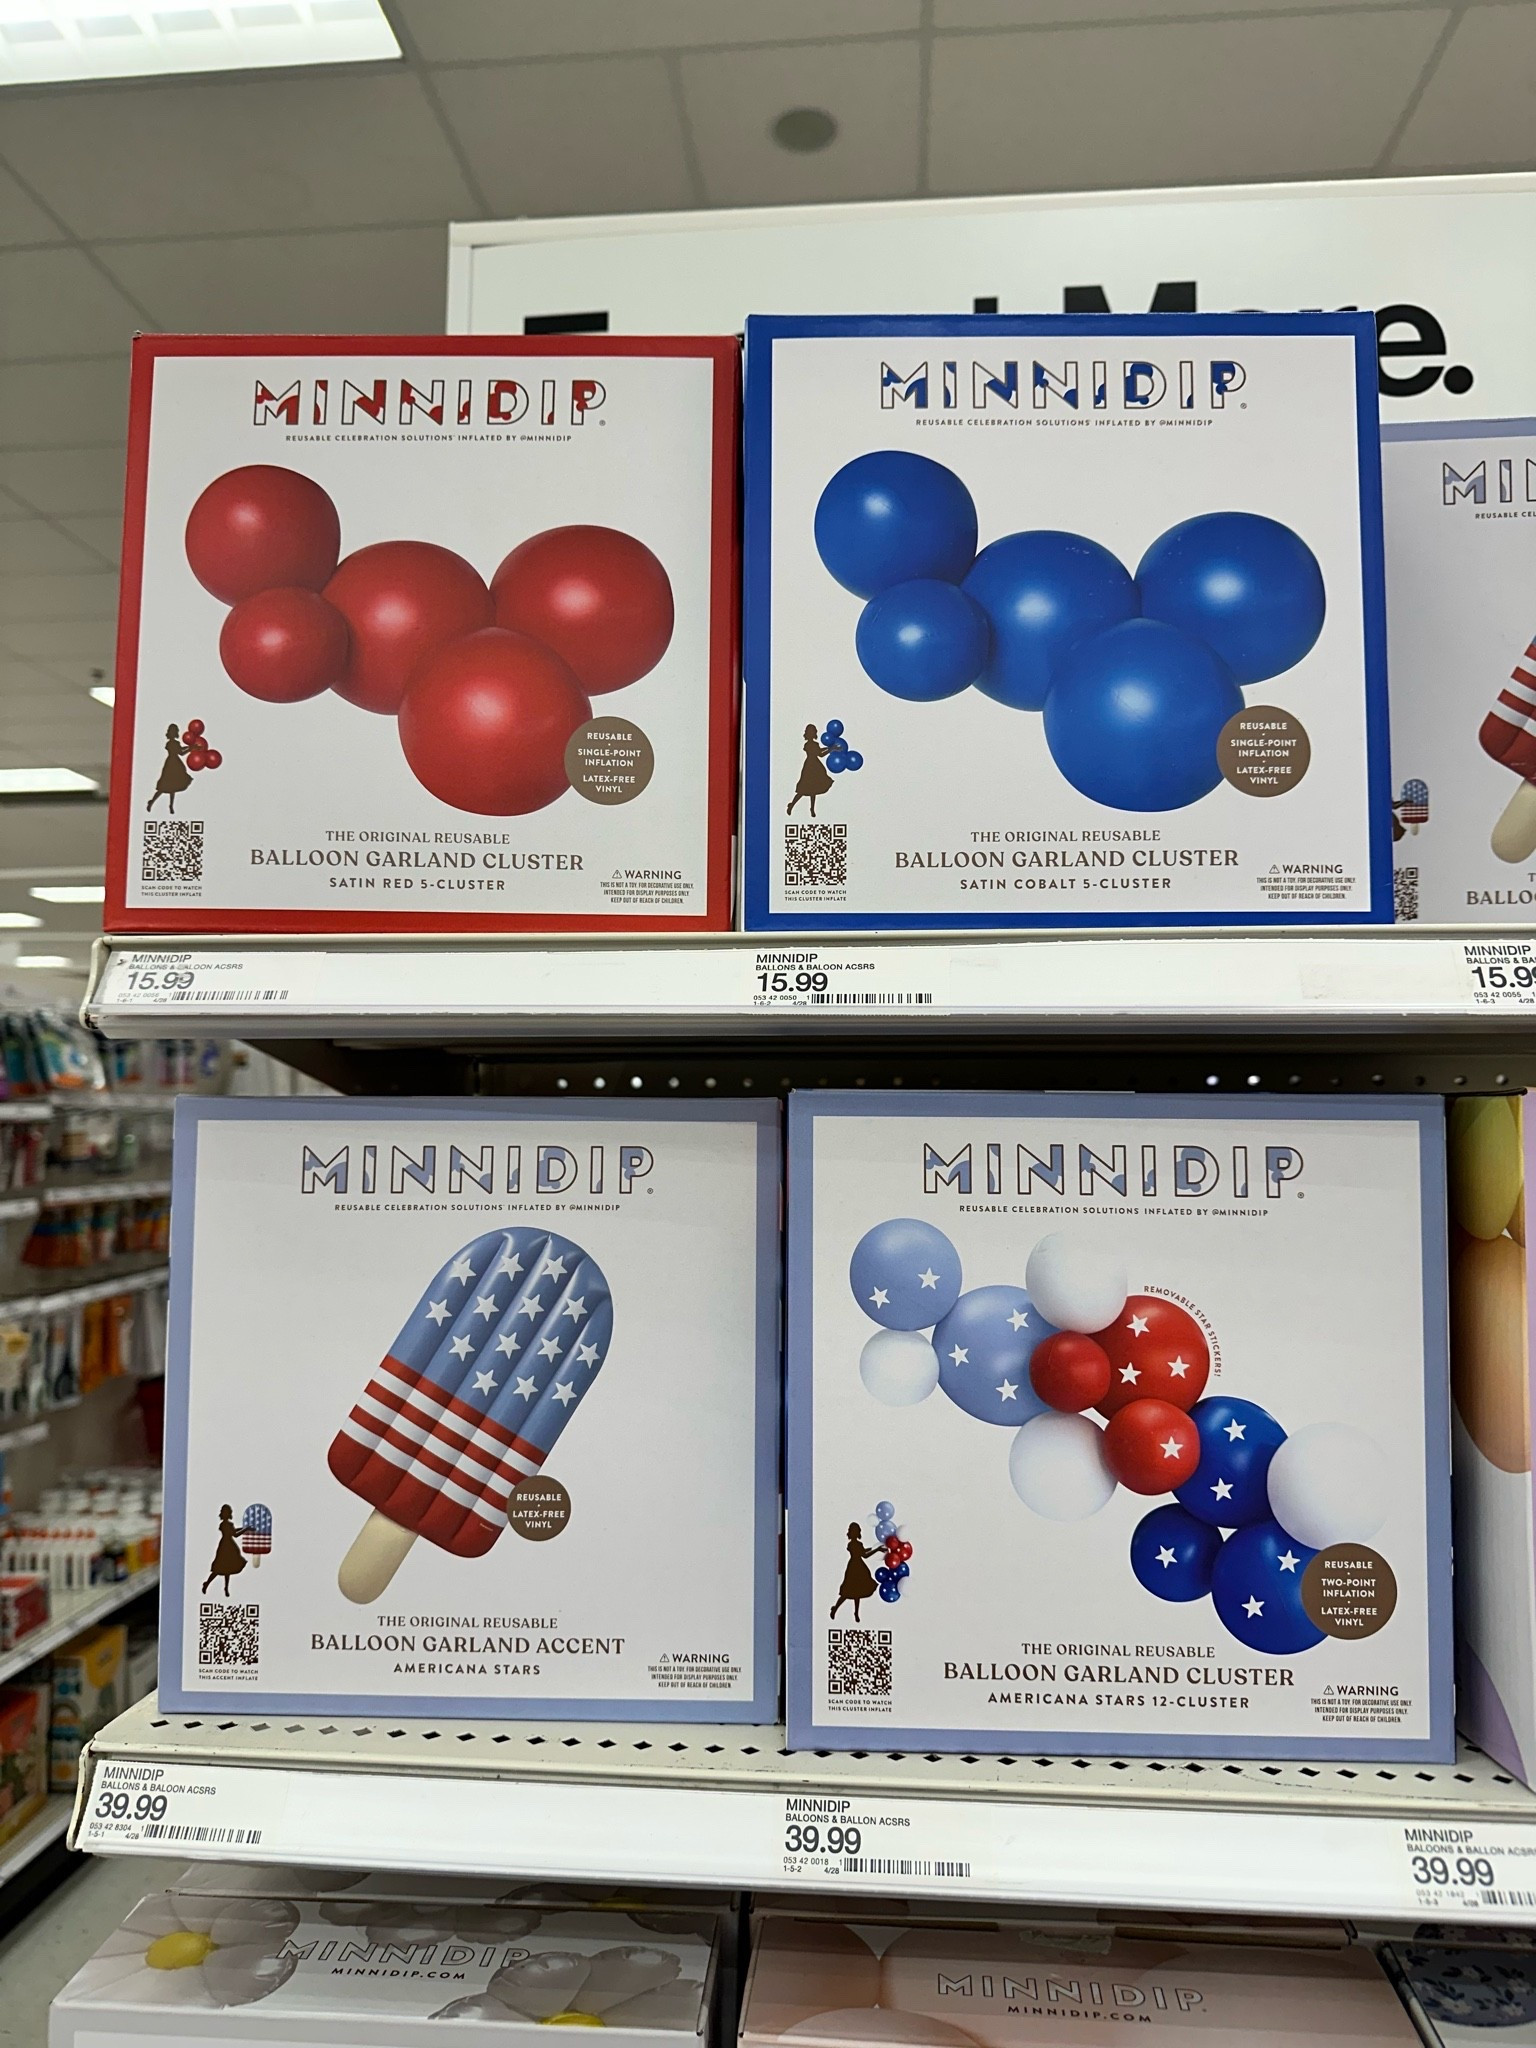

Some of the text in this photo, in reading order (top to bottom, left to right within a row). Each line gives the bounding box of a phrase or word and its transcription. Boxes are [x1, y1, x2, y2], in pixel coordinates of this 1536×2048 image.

[881, 360, 1247, 410] MINNIDIP
[253, 379, 606, 426] MINNIDIP
[1240, 722, 1287, 730] REUSABLE
[587, 732, 632, 740] REUSABLE
[578, 748, 641, 757] SINGLE-POINT
[1237, 766, 1291, 774] LATEX-FREE
[583, 775, 635, 783] LATEX-FREE
[595, 785, 622, 793] VINYL
[325, 831, 510, 844] THE ORIGINAL REUSABLE
[971, 830, 1160, 842] THE ORIGINAL REUSABLE
[251, 849, 583, 870] BALLOON GARLAND CLUSTER
[896, 850, 1239, 868] BALLOON GARLAND CLUSTER
[625, 870, 681, 880] WARNING
[1283, 864, 1343, 874] WARNING
[330, 877, 504, 890] SATIN RED 5-CLUSTER
[960, 878, 1170, 889] SATIN COBALT 5-CLUSTER
[1467, 890, 1536, 905] BALLO
[1464, 945, 1531, 955] MINNIDIP
[132, 954, 192, 963] MINNIDIP
[757, 953, 818, 963] MINNIDIP
[127, 971, 195, 990] 15.99
[757, 972, 828, 992] 15.99
[1472, 966, 1536, 988] 15.9
[301, 1145, 654, 1194] MINNIDIP
[924, 1143, 1304, 1199] MINNIDIP
[1144, 1285, 1196, 1310] REMOVABLE
[1194, 1309, 1211, 1329] STAR
[513, 1510, 565, 1518] LATEX-FREE
[1325, 1561, 1372, 1569] REUSABLE
[1321, 1578, 1376, 1586] TWO-POINT
[1321, 1607, 1377, 1615] LATEX-FREE
[377, 1616, 557, 1628] THE ORIGINAL REUSABLE
[1335, 1618, 1364, 1626] VINYL
[312, 1634, 625, 1654] BALLOON GARLAND ACCENT
[1021, 1643, 1215, 1658] THE ORIGINAL REUSABLE
[672, 1654, 729, 1663] WARNING
[394, 1663, 540, 1675] AMERICANA STARS
[944, 1662, 1294, 1686] BALLOON GARLAND CLUSTER
[1337, 1685, 1398, 1696] WARNING
[988, 1692, 1248, 1708] AMERICANA STARS 12-CLUSTER
[104, 1766, 164, 1781] MINNIDIP
[101, 1781, 216, 1795] BALLONS & BALOON ACSRS
[95, 1792, 167, 1821] 39.99
[787, 1798, 850, 1813] MINNIDIP
[89, 1822, 103, 1830] 053
[786, 1813, 910, 1826] BALOONS & BALLON ACSRS
[785, 1825, 861, 1854] 39.99
[1404, 1829, 1473, 1842] MINNIDIP
[1407, 1844, 1454, 1854] BALOONS
[1465, 1846, 1505, 1855] BALLON
[783, 1856, 797, 1864] 053
[1412, 1856, 1494, 1886] 39.99
[276, 1940, 531, 1968] MINNIDIP
[331, 1968, 466, 1980] MINNIDIP.COM
[937, 1973, 1203, 2012] MINNIDIP
[1007, 2005, 1152, 2023] MINNIDIP.COM
